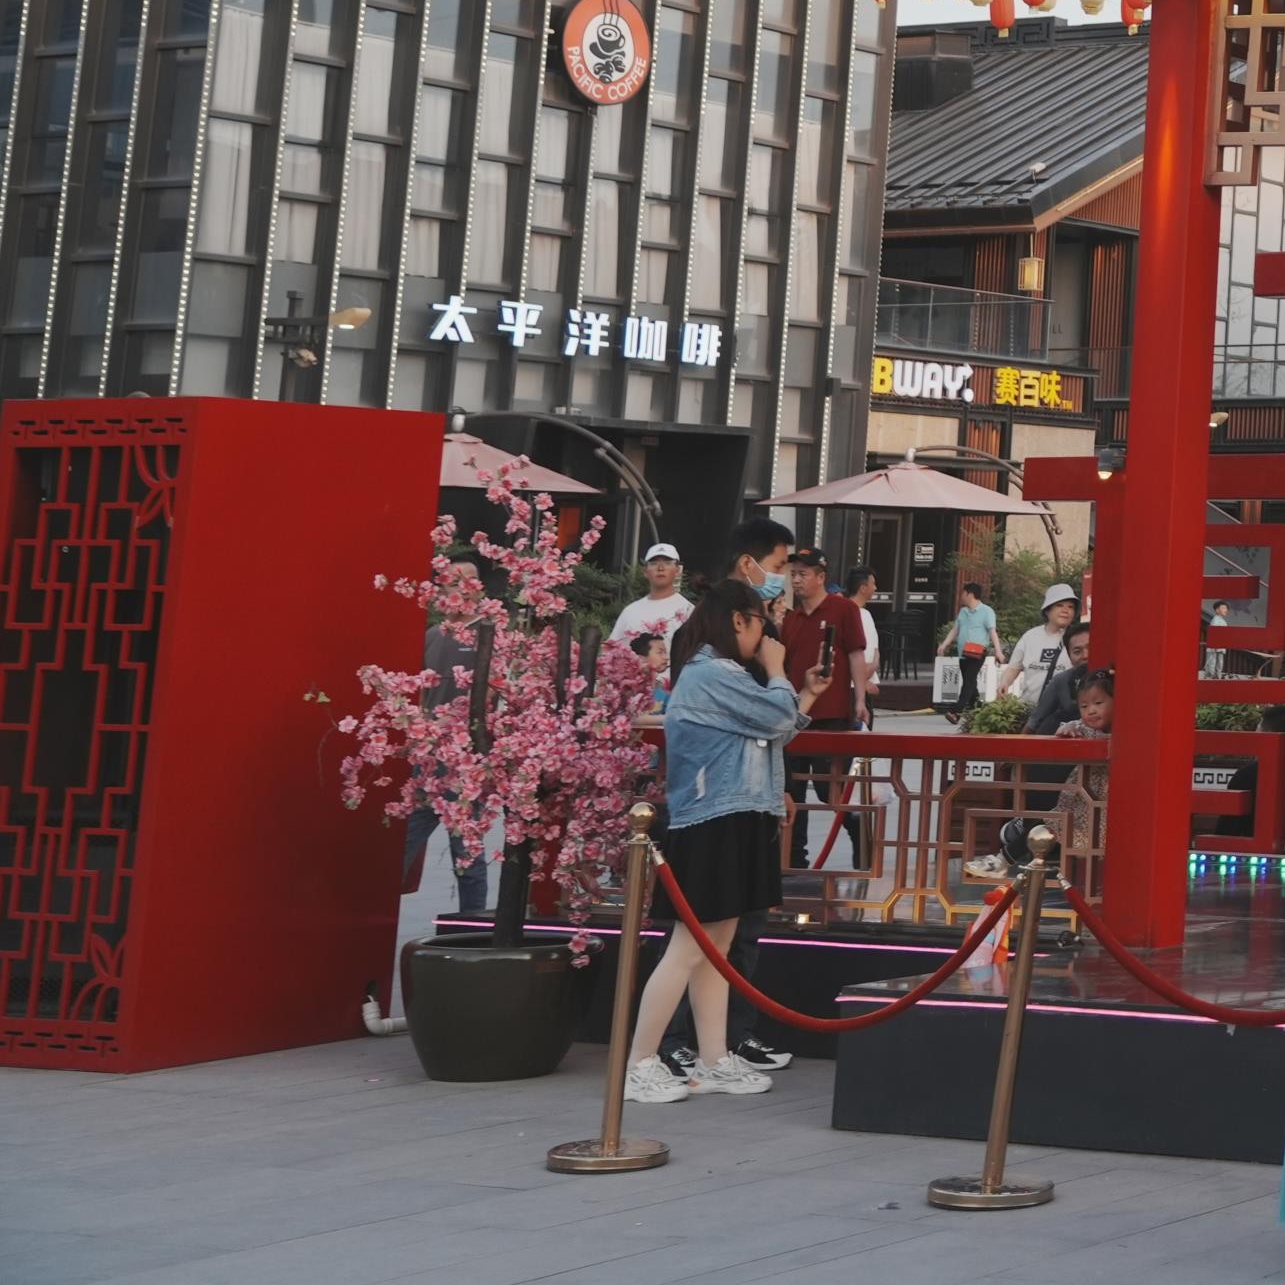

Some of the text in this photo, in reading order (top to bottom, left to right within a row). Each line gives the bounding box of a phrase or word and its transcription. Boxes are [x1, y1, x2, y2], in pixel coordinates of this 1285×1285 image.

[568, 46, 646, 100] PACIFIC COFFEE
[429, 295, 722, 366] 太平洋咖啡
[994, 366, 1062, 408] 赛百味
